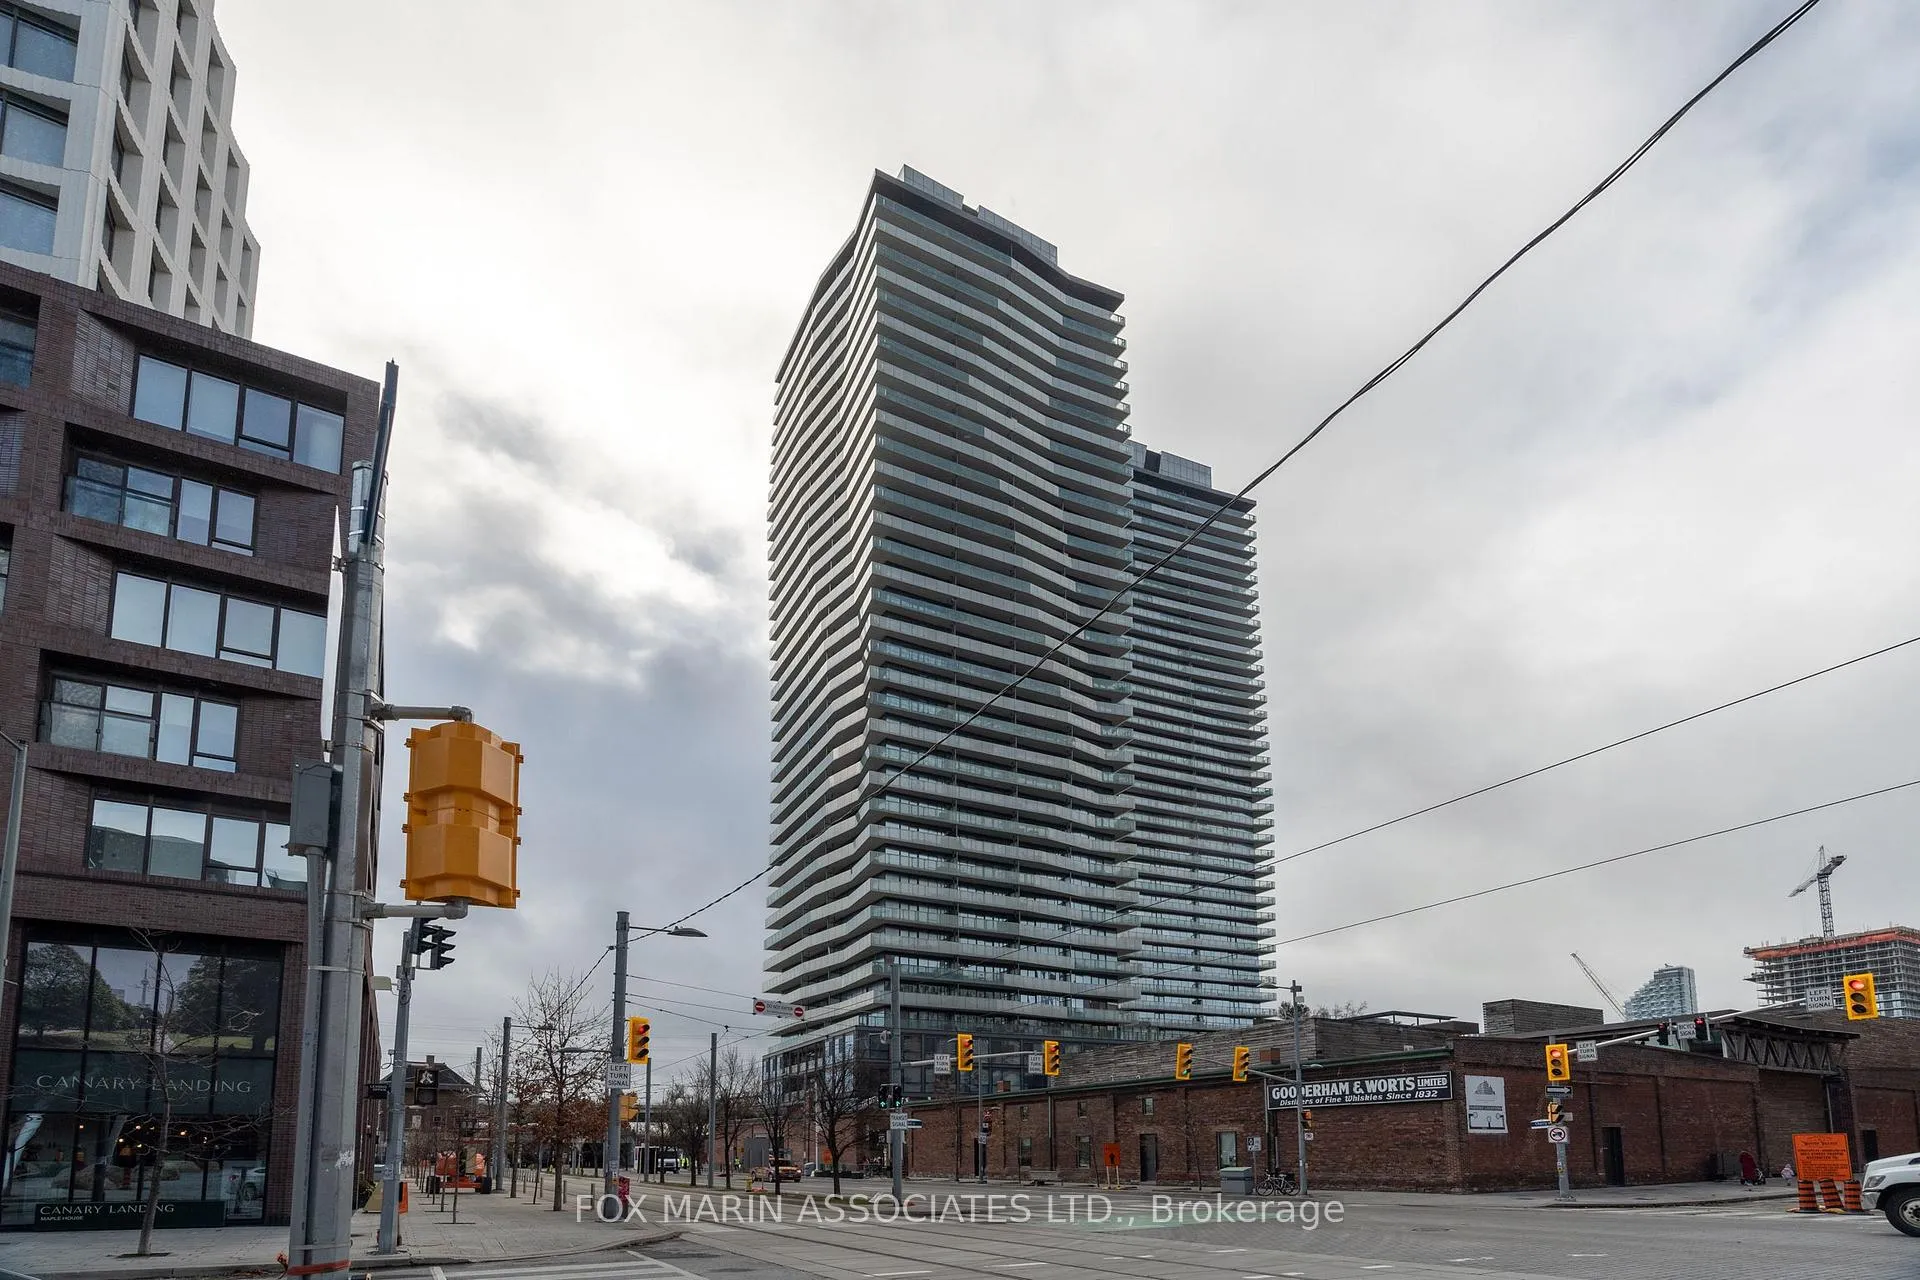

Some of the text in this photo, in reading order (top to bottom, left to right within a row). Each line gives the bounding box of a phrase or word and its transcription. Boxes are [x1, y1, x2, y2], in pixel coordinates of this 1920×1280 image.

[36, 1074, 251, 1093] CANARY LANDING
[1352, 1080, 1365, 1095] &
[1365, 1076, 1415, 1094] WORTS
[1417, 1077, 1448, 1087] LIMITED
[1279, 1098, 1314, 1106] Distilers
[1314, 1096, 1324, 1104] of
[1344, 1092, 1383, 1102] Whiskies
[1385, 1092, 1412, 1100] Since
[1414, 1090, 1438, 1098] 1832
[40, 1203, 175, 1215] CANARY LANDNG
